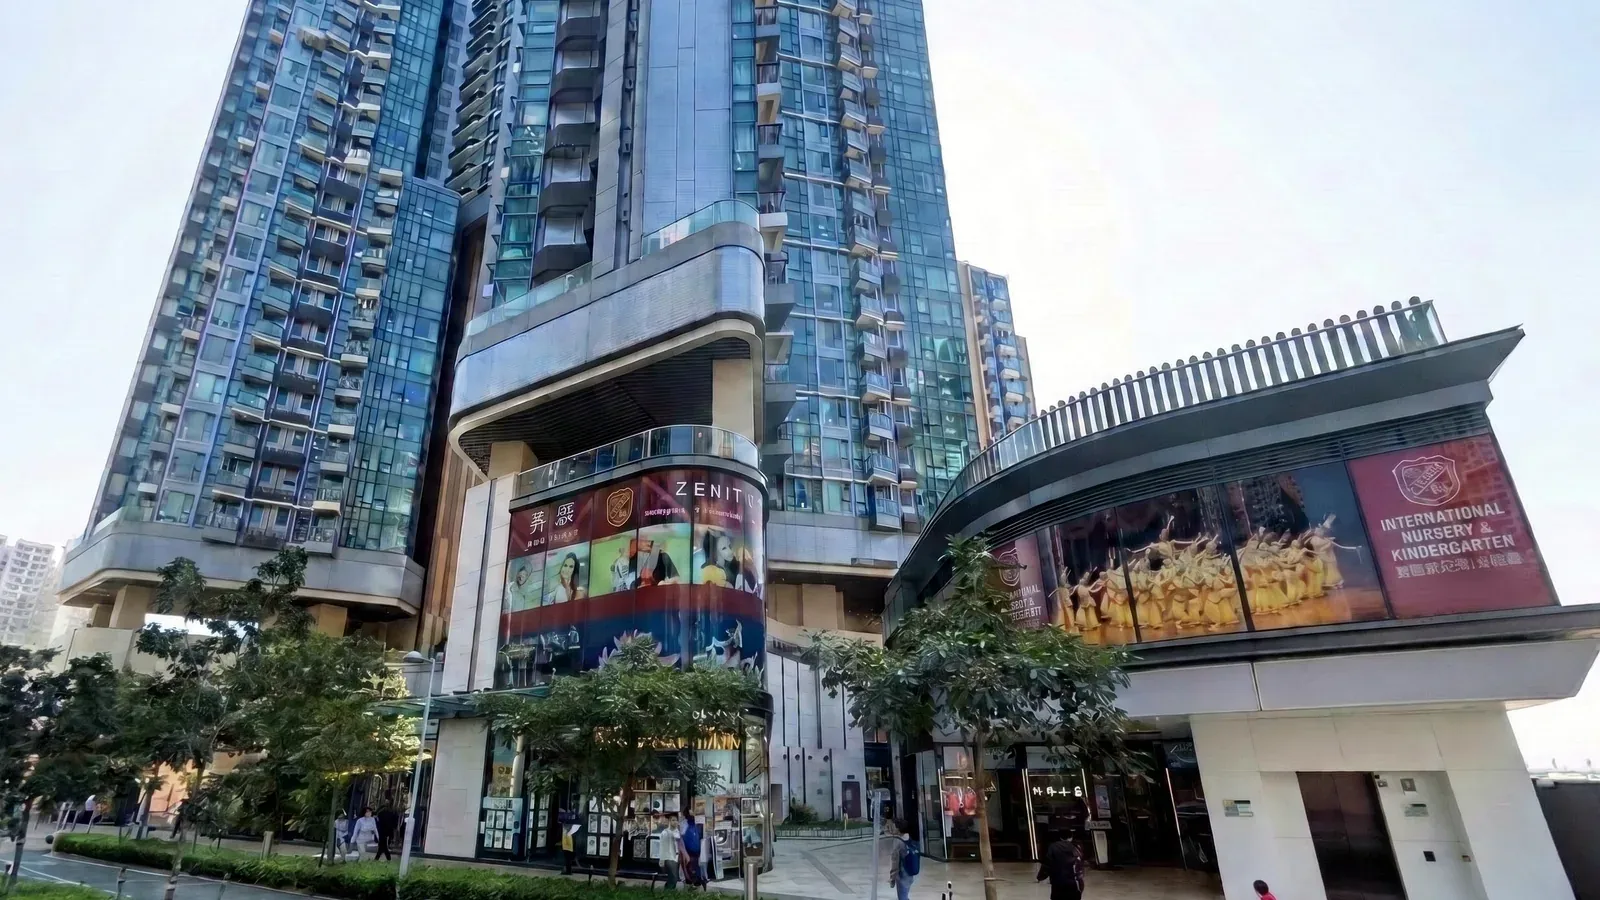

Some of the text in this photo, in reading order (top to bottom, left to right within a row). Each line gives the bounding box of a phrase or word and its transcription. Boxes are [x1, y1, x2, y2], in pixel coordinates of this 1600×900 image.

[1380, 502, 1504, 531] INTERNATIONAL
[1401, 521, 1494, 543] NURSERY &
[1391, 534, 1515, 561] KINDERGARTEN
